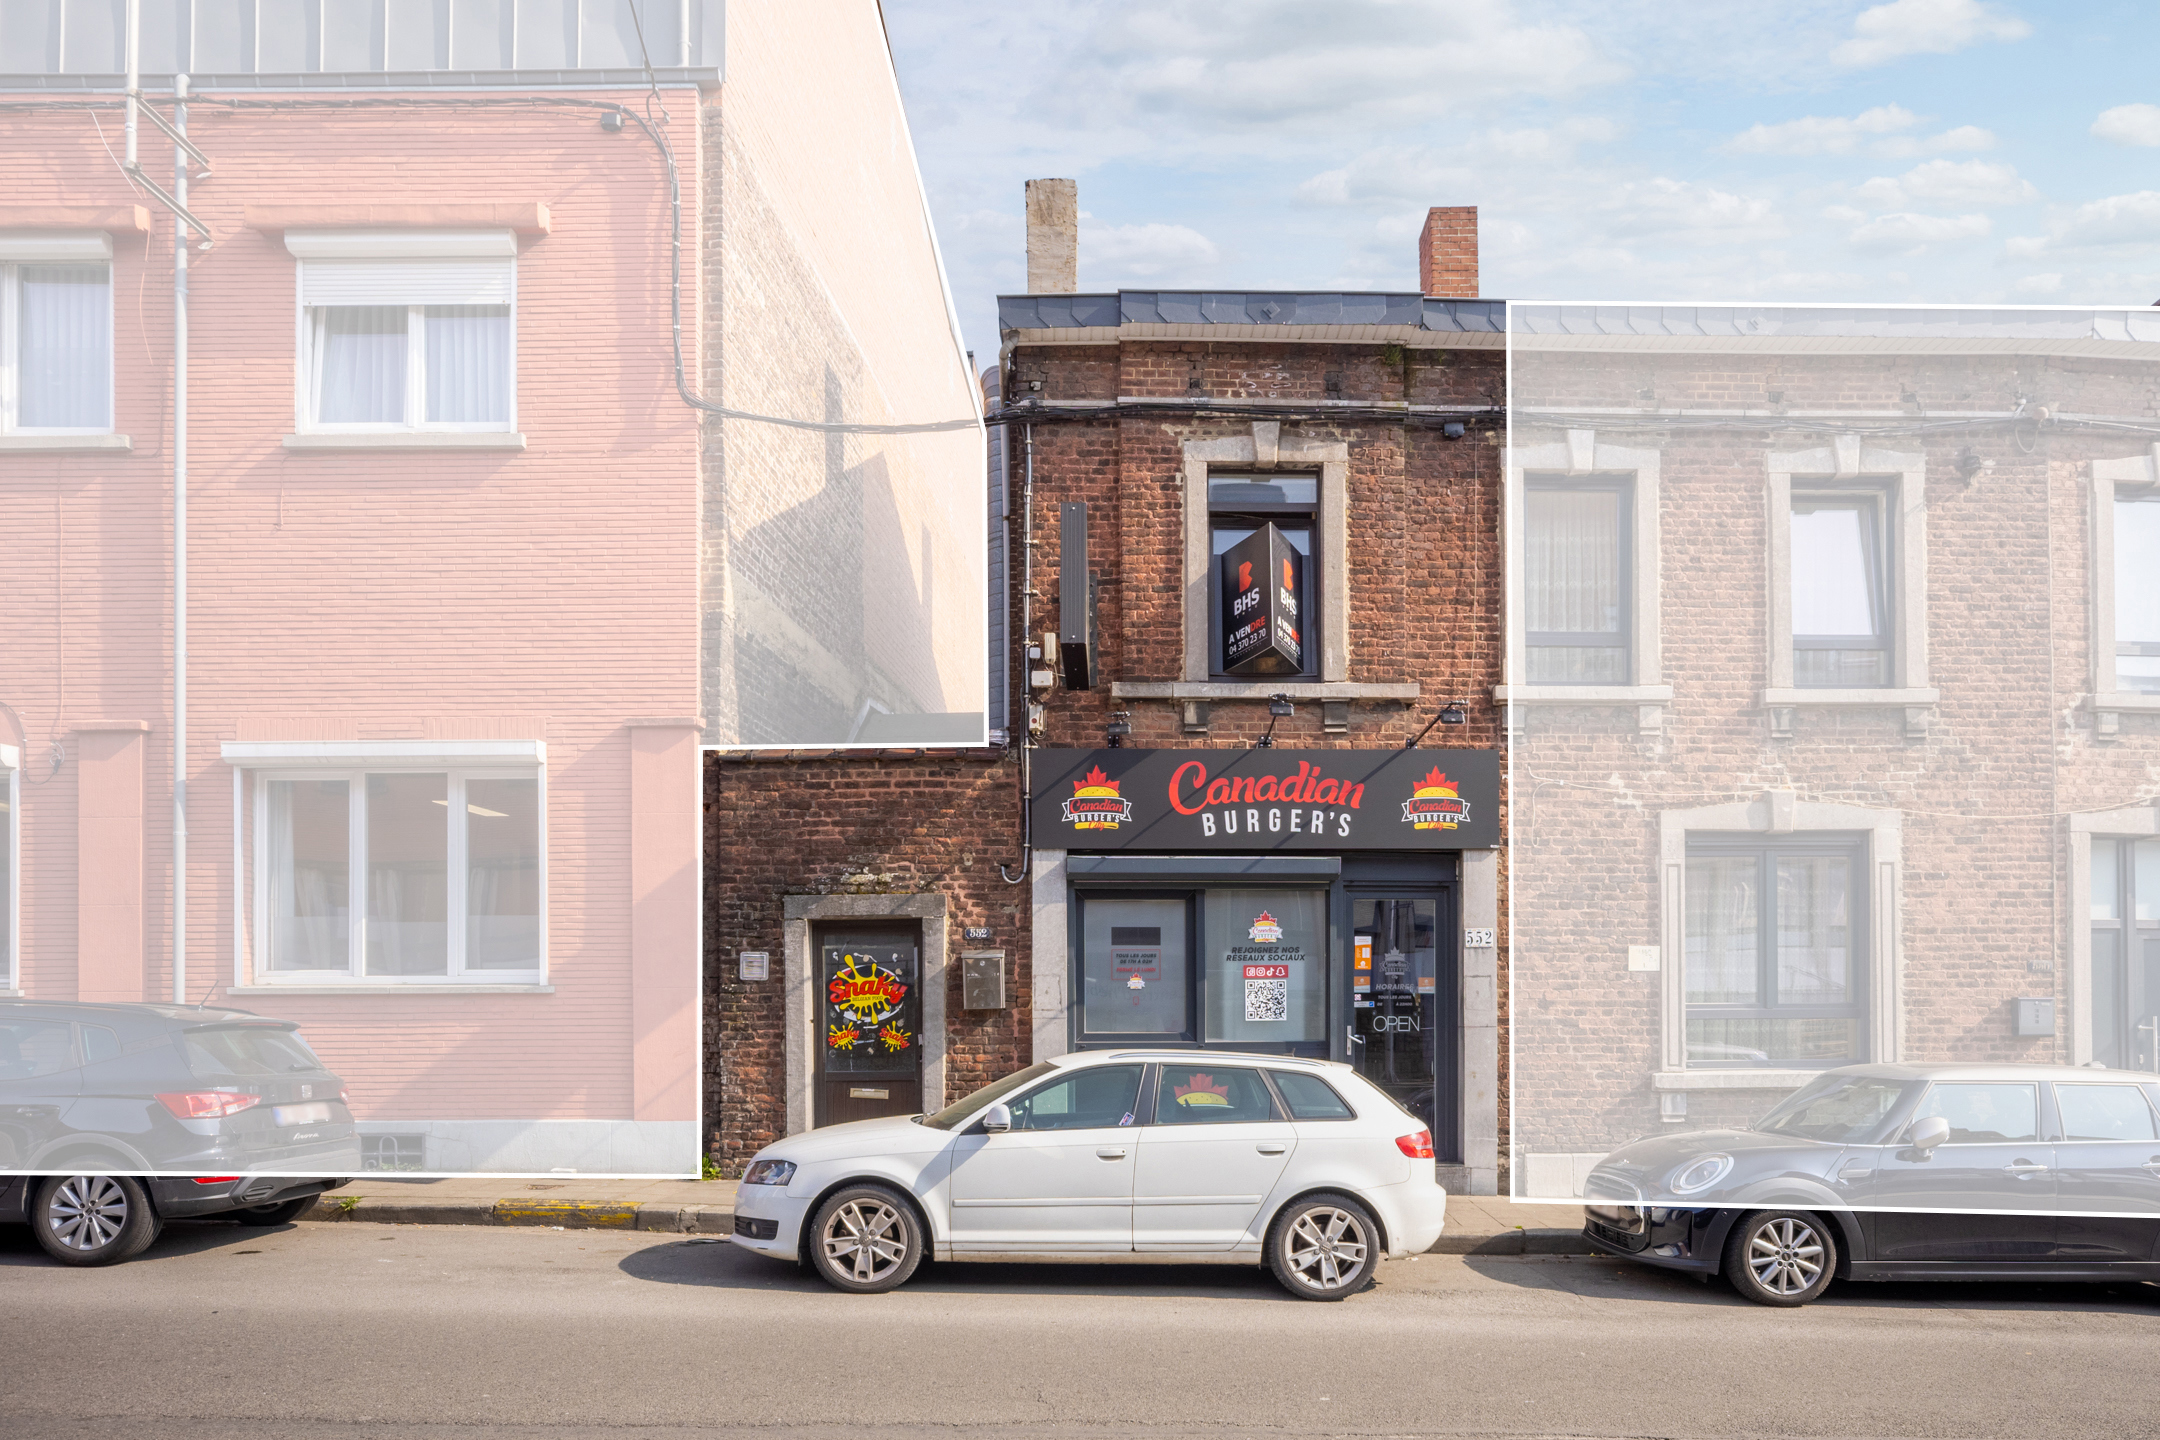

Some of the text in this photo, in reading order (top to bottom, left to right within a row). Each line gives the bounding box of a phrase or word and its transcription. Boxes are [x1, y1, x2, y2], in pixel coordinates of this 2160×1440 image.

[1233, 587, 1260, 616] BHS
[1280, 586, 1298, 616] BHS
[1228, 615, 1266, 645] A VENDRE
[1229, 644, 1237, 655] 04
[1238, 637, 1249, 651] 370
[1250, 632, 1258, 644] 23
[1258, 627, 1267, 639] 70
[1168, 760, 1365, 816] Canadian
[1069, 798, 1123, 814] Canadian
[1409, 799, 1462, 814] Canadian
[1073, 813, 1120, 823] BURGER'S
[1088, 820, 1105, 831] City
[1201, 808, 1352, 837] BURGER'S
[1413, 814, 1459, 823] BURGER'S
[1428, 820, 1444, 831] City
[969, 928, 987, 938] 552
[1467, 931, 1492, 945] 552
[1231, 946, 1280, 954] REJOIGNEZ
[828, 975, 908, 1004] Snaky
[1373, 1015, 1420, 1032] OPEN
[828, 1028, 860, 1046] Snaky
[879, 1027, 910, 1049] Snaky
